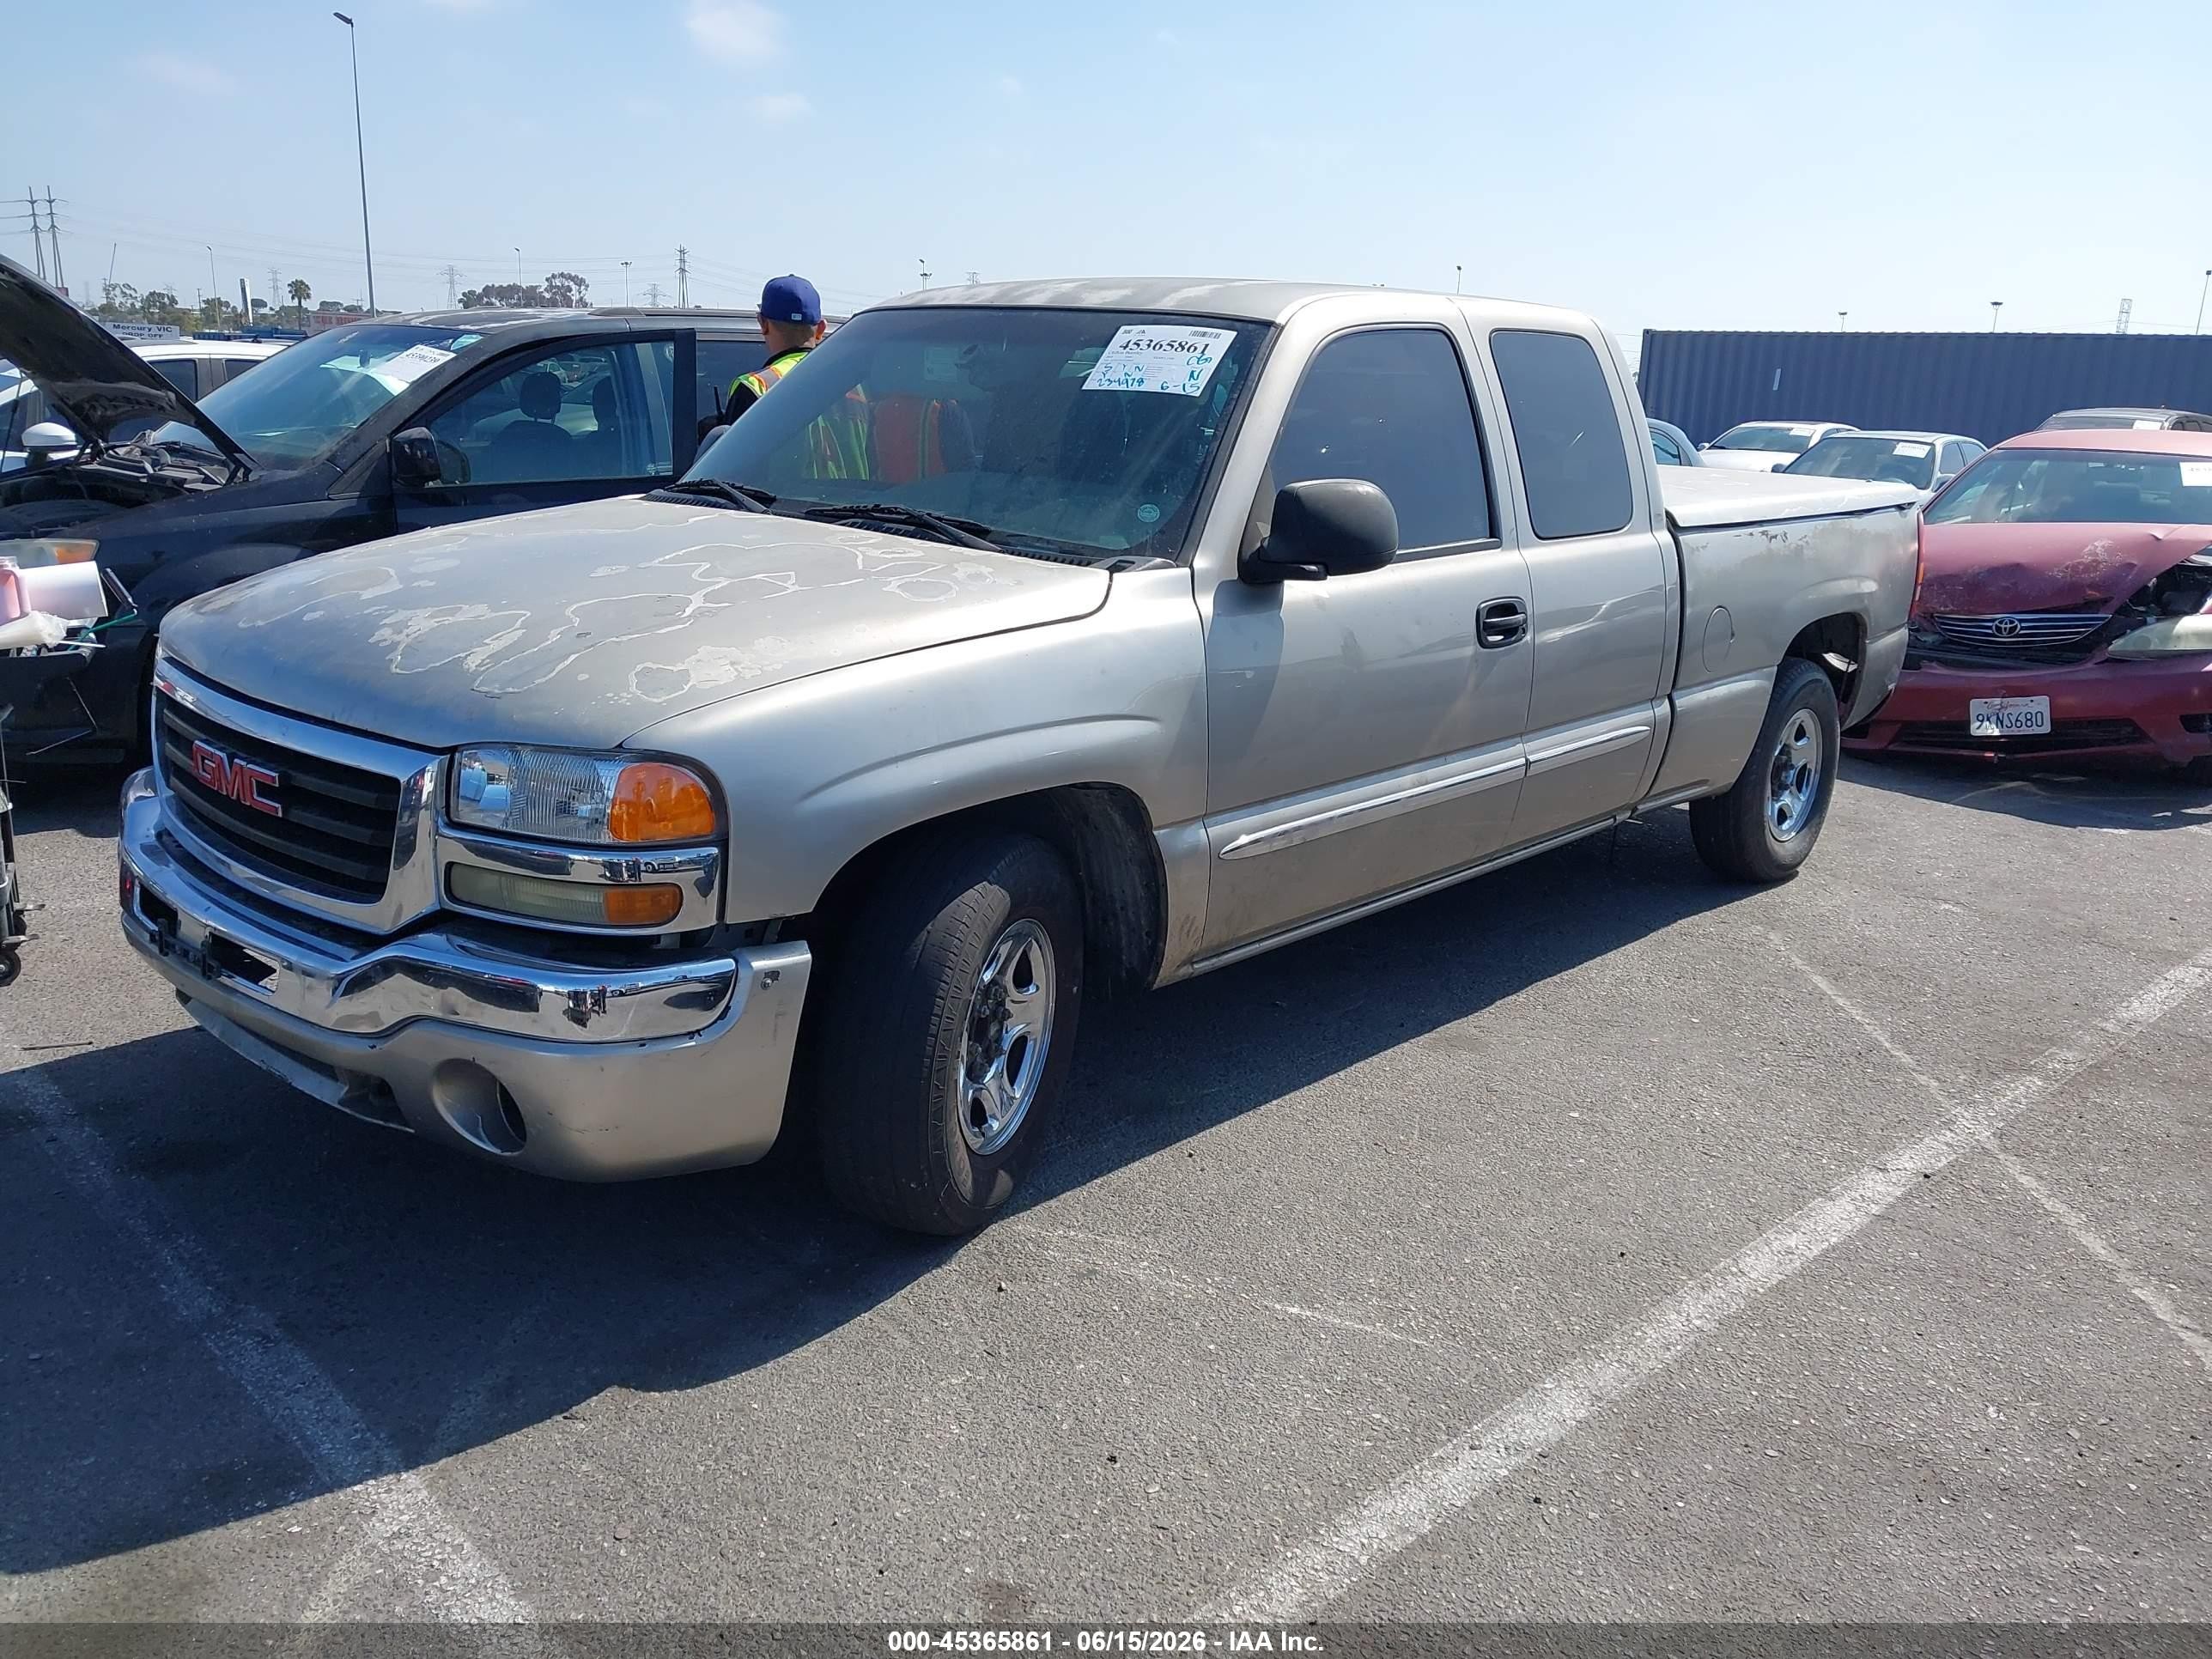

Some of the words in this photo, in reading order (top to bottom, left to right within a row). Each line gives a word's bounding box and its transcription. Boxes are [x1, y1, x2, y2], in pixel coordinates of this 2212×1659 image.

[112, 324, 152, 332] Mercury
[1119, 338, 1210, 355] 45365861
[1976, 711, 2044, 730] 9KNS680
[192, 740, 282, 817] GMC
